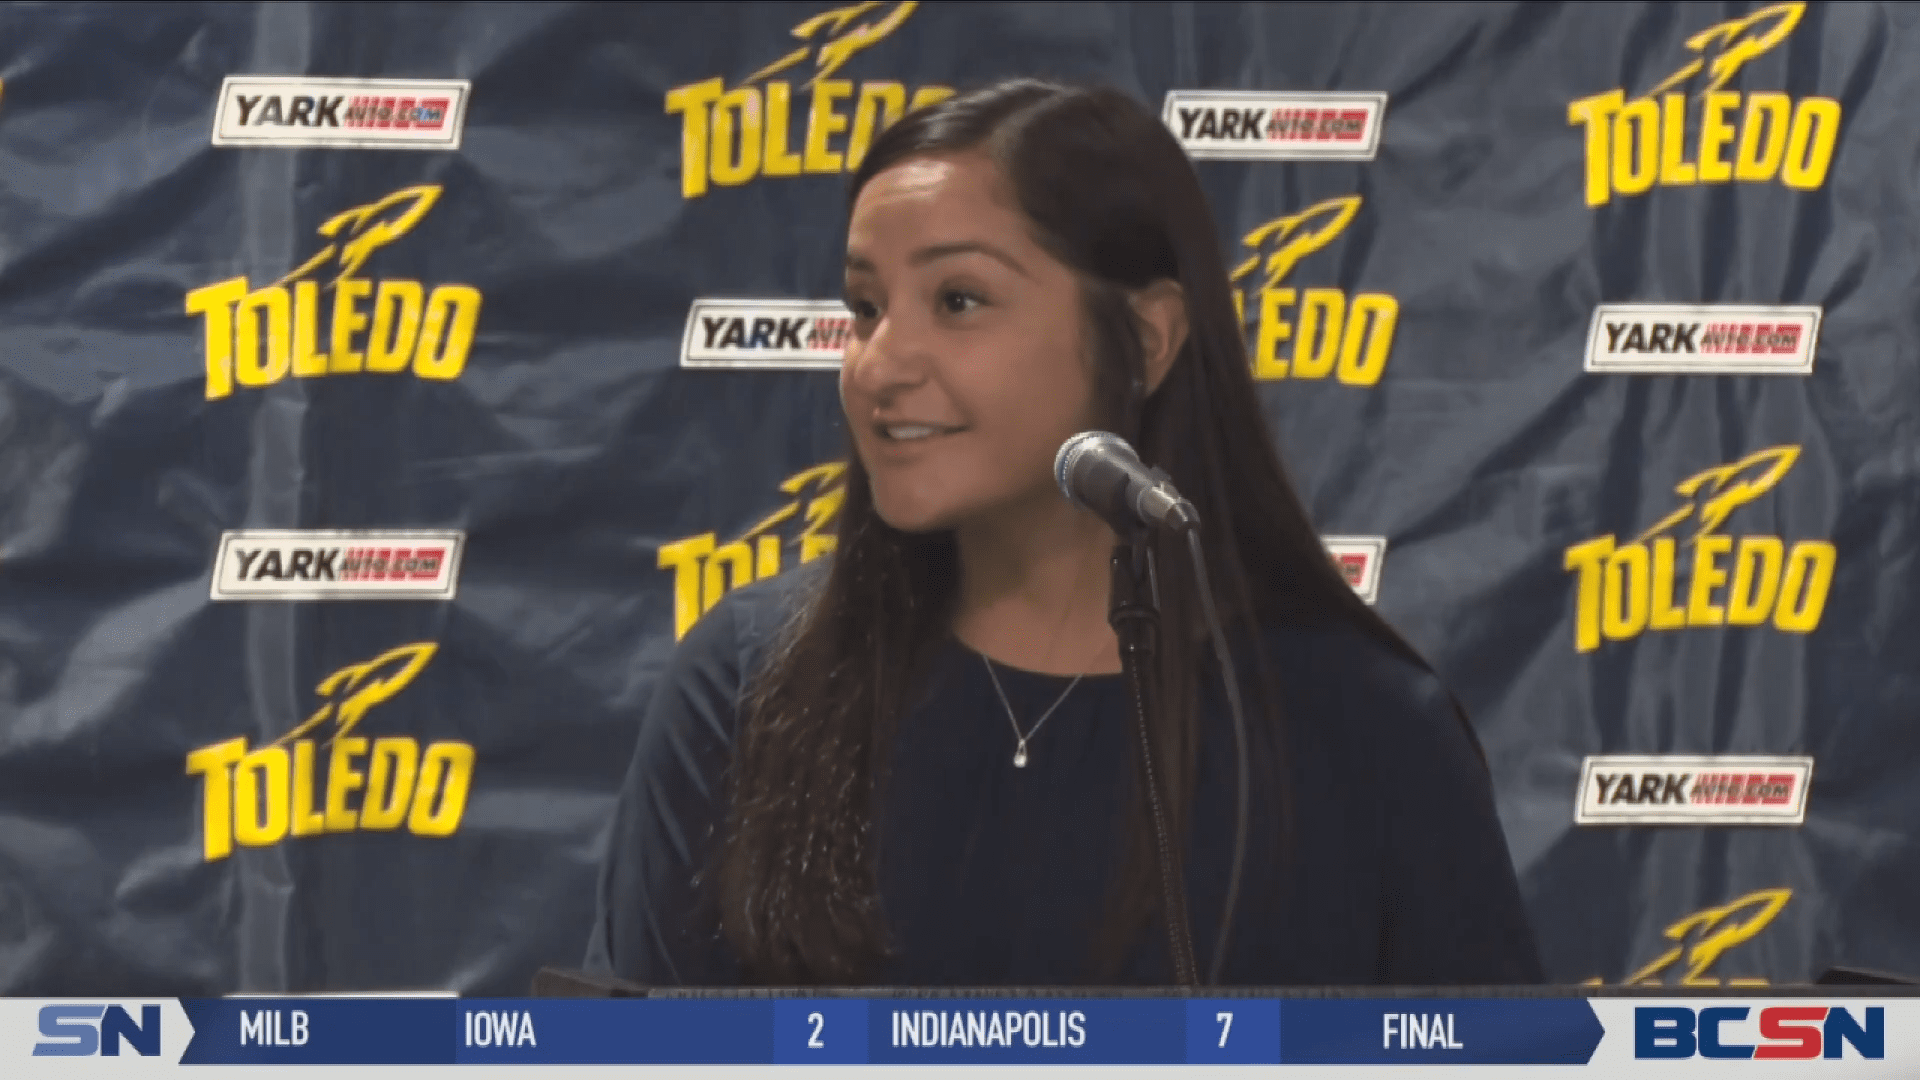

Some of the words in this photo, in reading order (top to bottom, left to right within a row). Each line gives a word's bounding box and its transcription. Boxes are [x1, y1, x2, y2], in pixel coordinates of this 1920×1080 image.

[665, 76, 956, 199] TOLED
[1567, 87, 1842, 208] TOLEDO
[185, 275, 483, 401] TOLEDO
[1565, 533, 1837, 653] TOLEDO
[186, 735, 475, 863] TOLEDO
